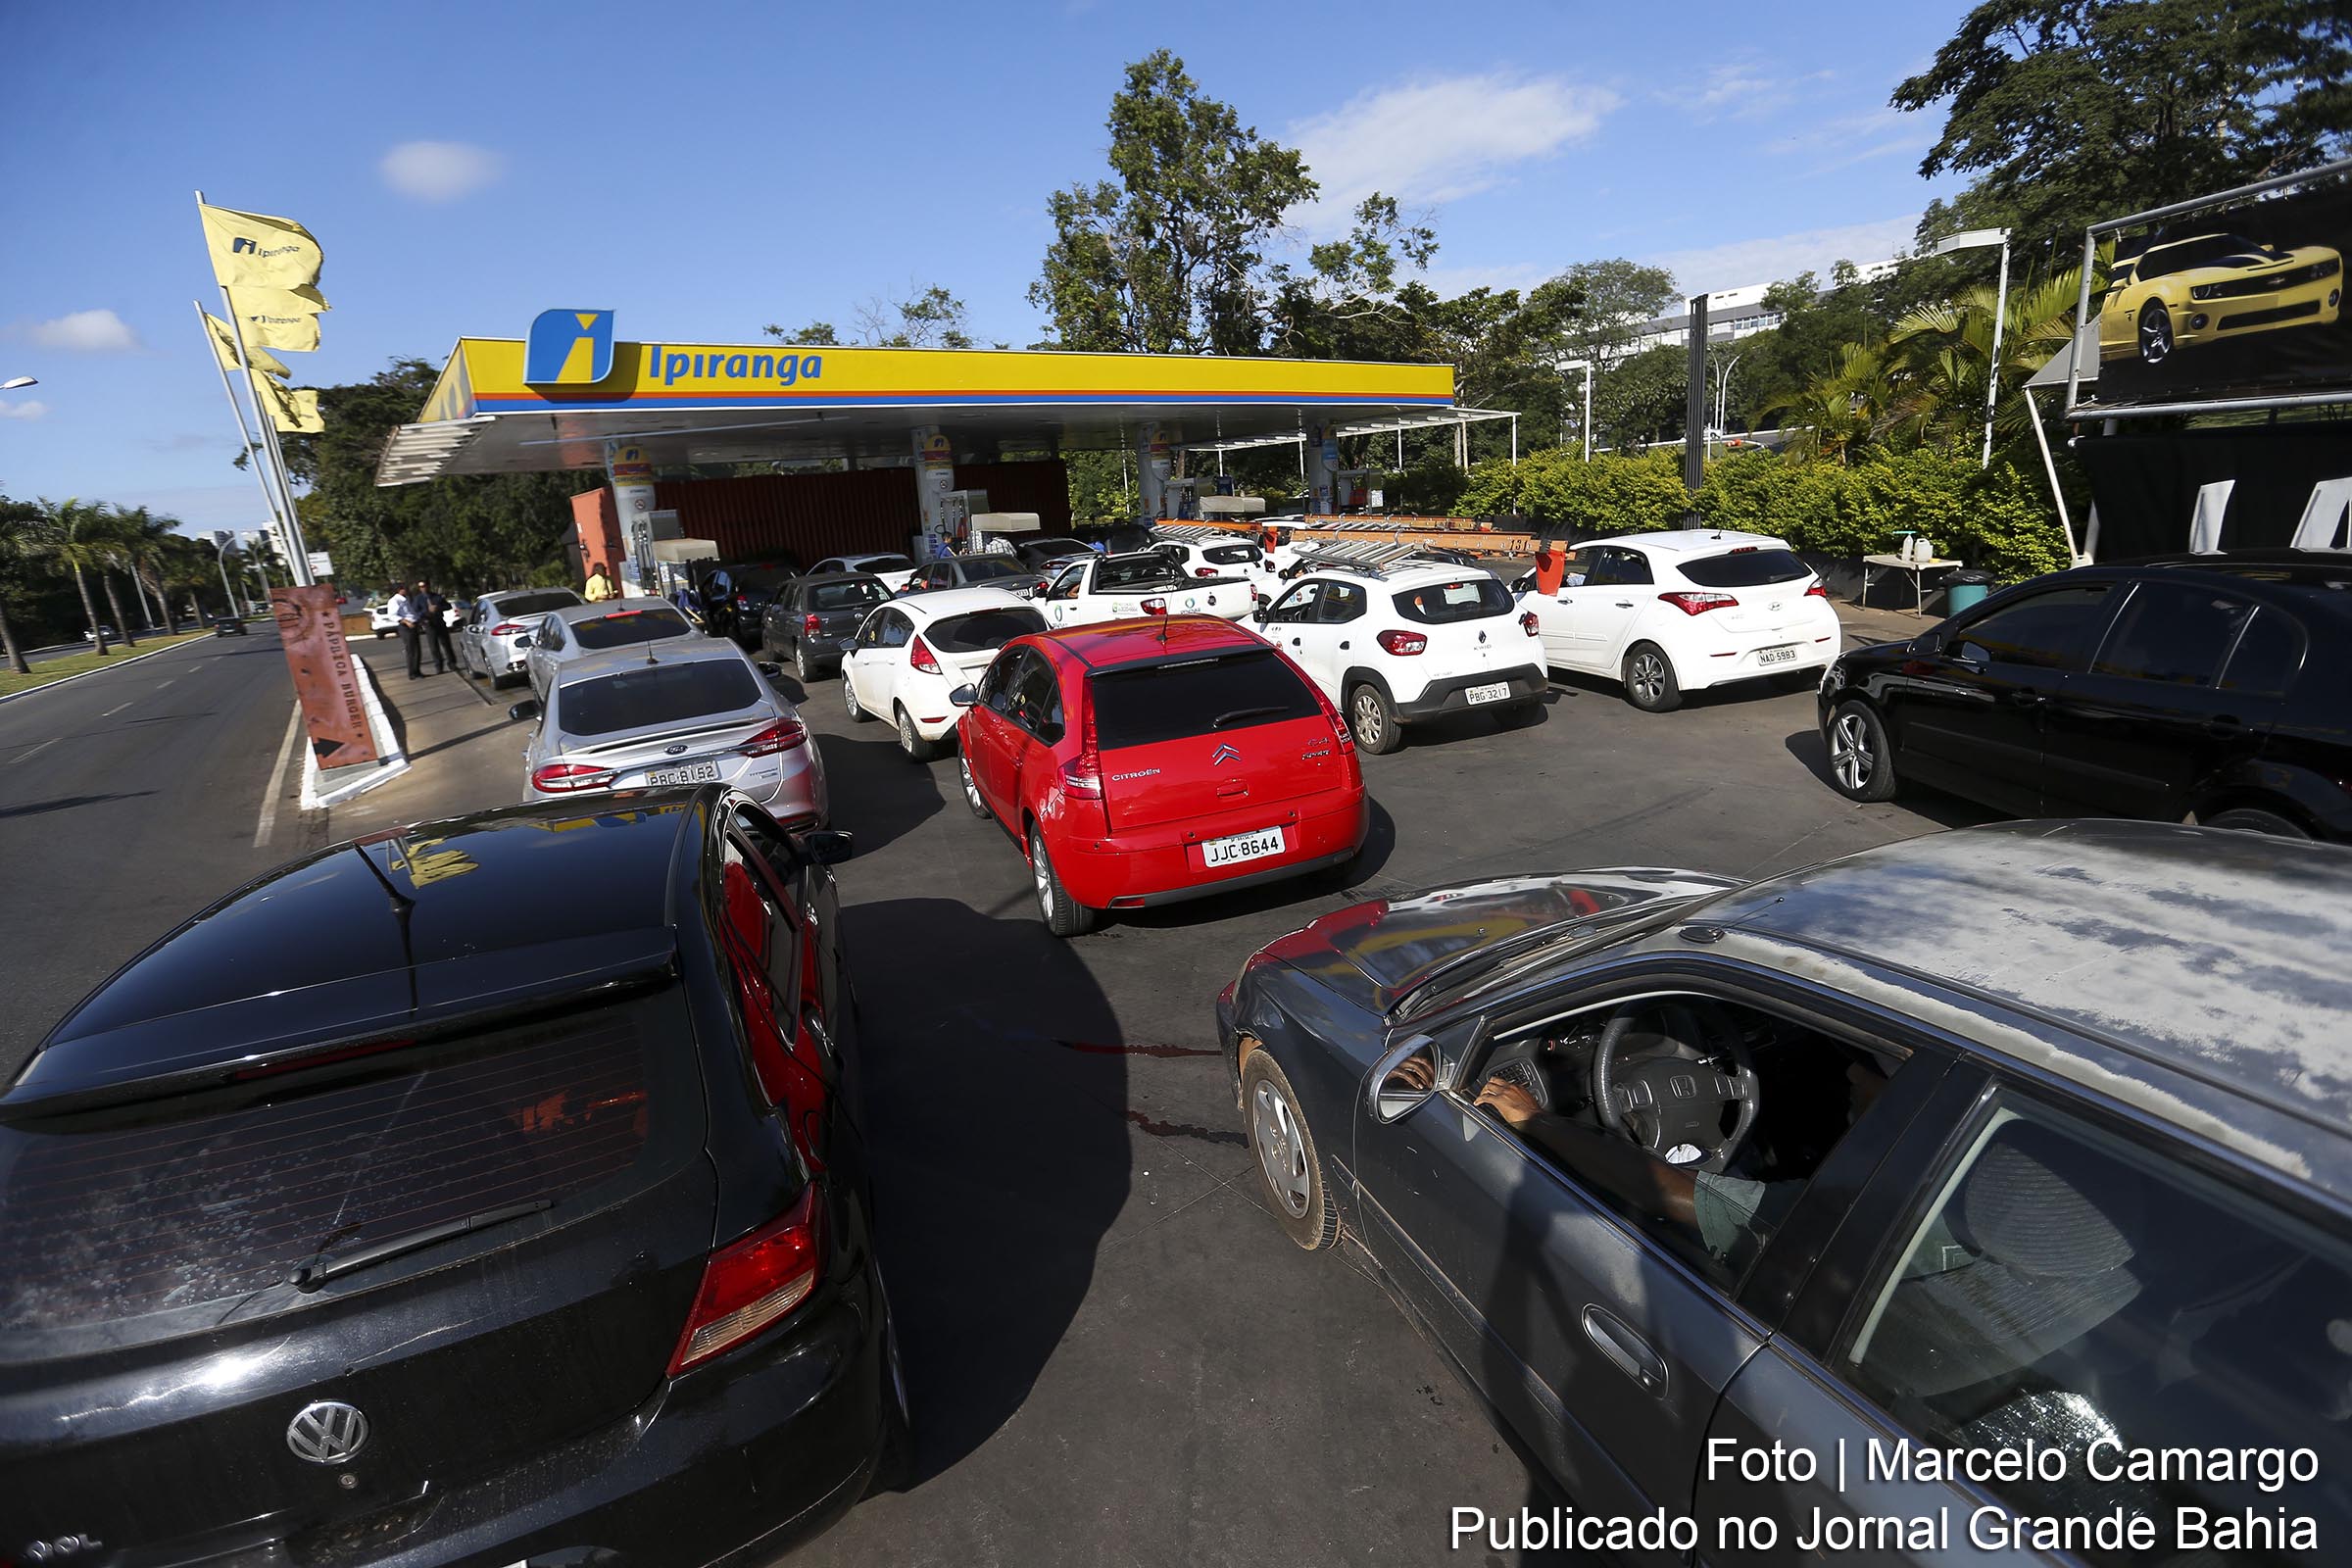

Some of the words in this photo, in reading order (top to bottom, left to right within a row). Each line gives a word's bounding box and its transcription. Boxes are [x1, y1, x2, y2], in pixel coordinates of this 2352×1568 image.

[650, 345, 822, 386] Ipiranga
[1510, 539, 1528, 551] 131
[341, 683, 362, 729] BURGER
